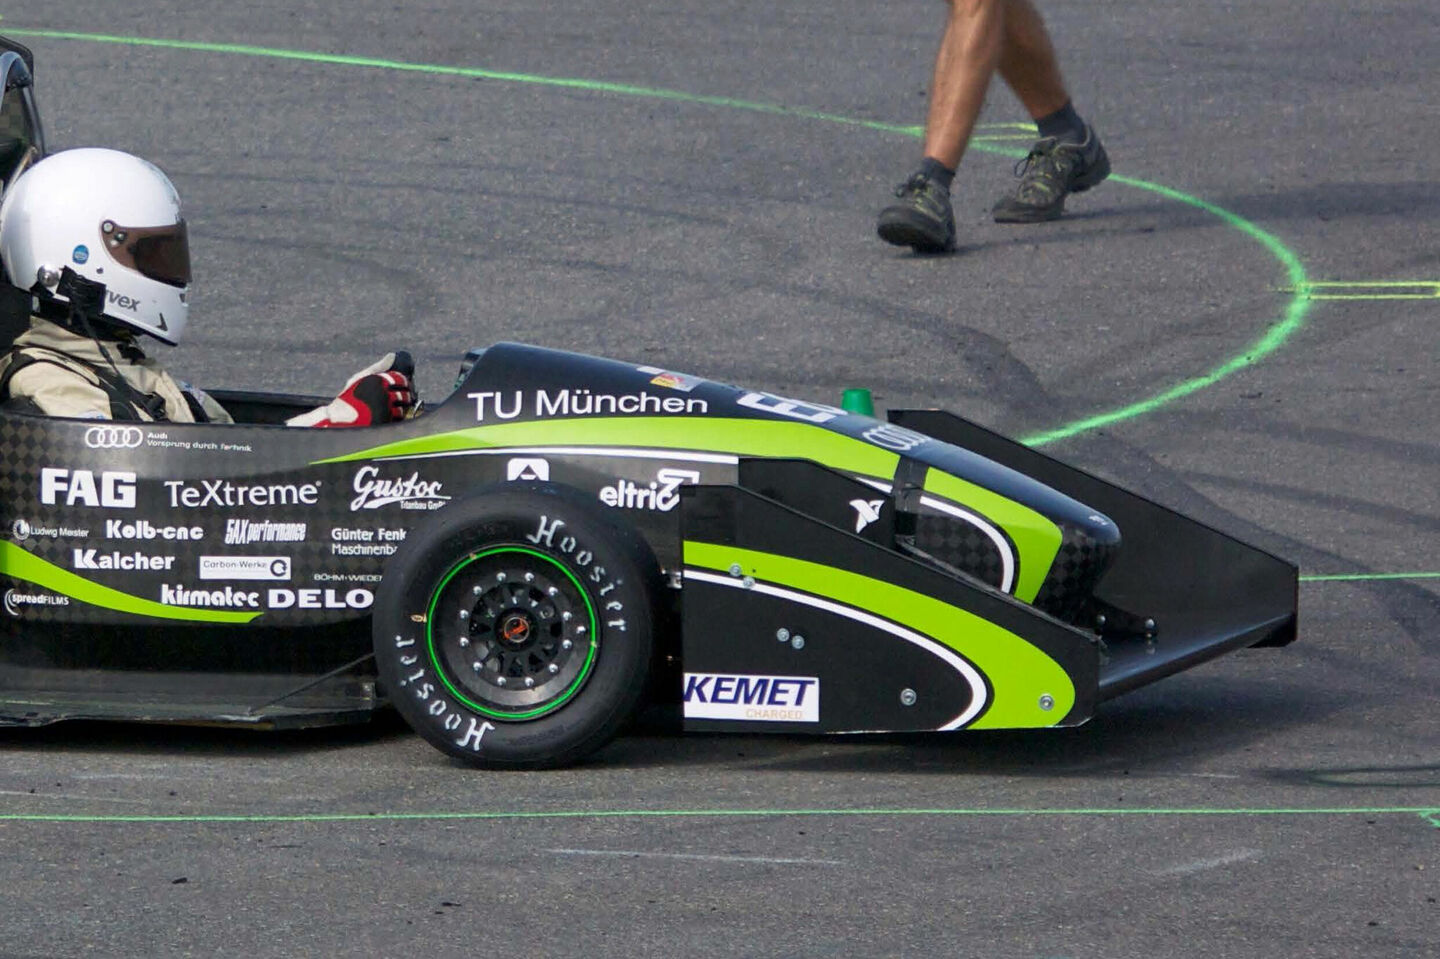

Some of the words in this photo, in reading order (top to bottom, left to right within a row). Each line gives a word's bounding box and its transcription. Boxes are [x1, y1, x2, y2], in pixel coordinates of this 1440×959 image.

[106, 290, 140, 312] vex
[468, 392, 522, 421] TU
[536, 389, 708, 417] München
[148, 432, 168, 440] Audi
[148, 440, 191, 450] Vorsprung
[193, 442, 217, 451] durch
[41, 467, 137, 508] FAG
[106, 519, 204, 540] Kolb-cnc
[331, 527, 374, 541] Günter
[73, 548, 176, 571] Kalcher
[526, 515, 628, 632] Hoosier
[11, 593, 70, 606] spreadFILMS
[161, 584, 260, 608] kirmatec
[268, 588, 375, 609] DELO
[394, 634, 496, 752] Hoosier
[684, 675, 816, 707] KEMET
